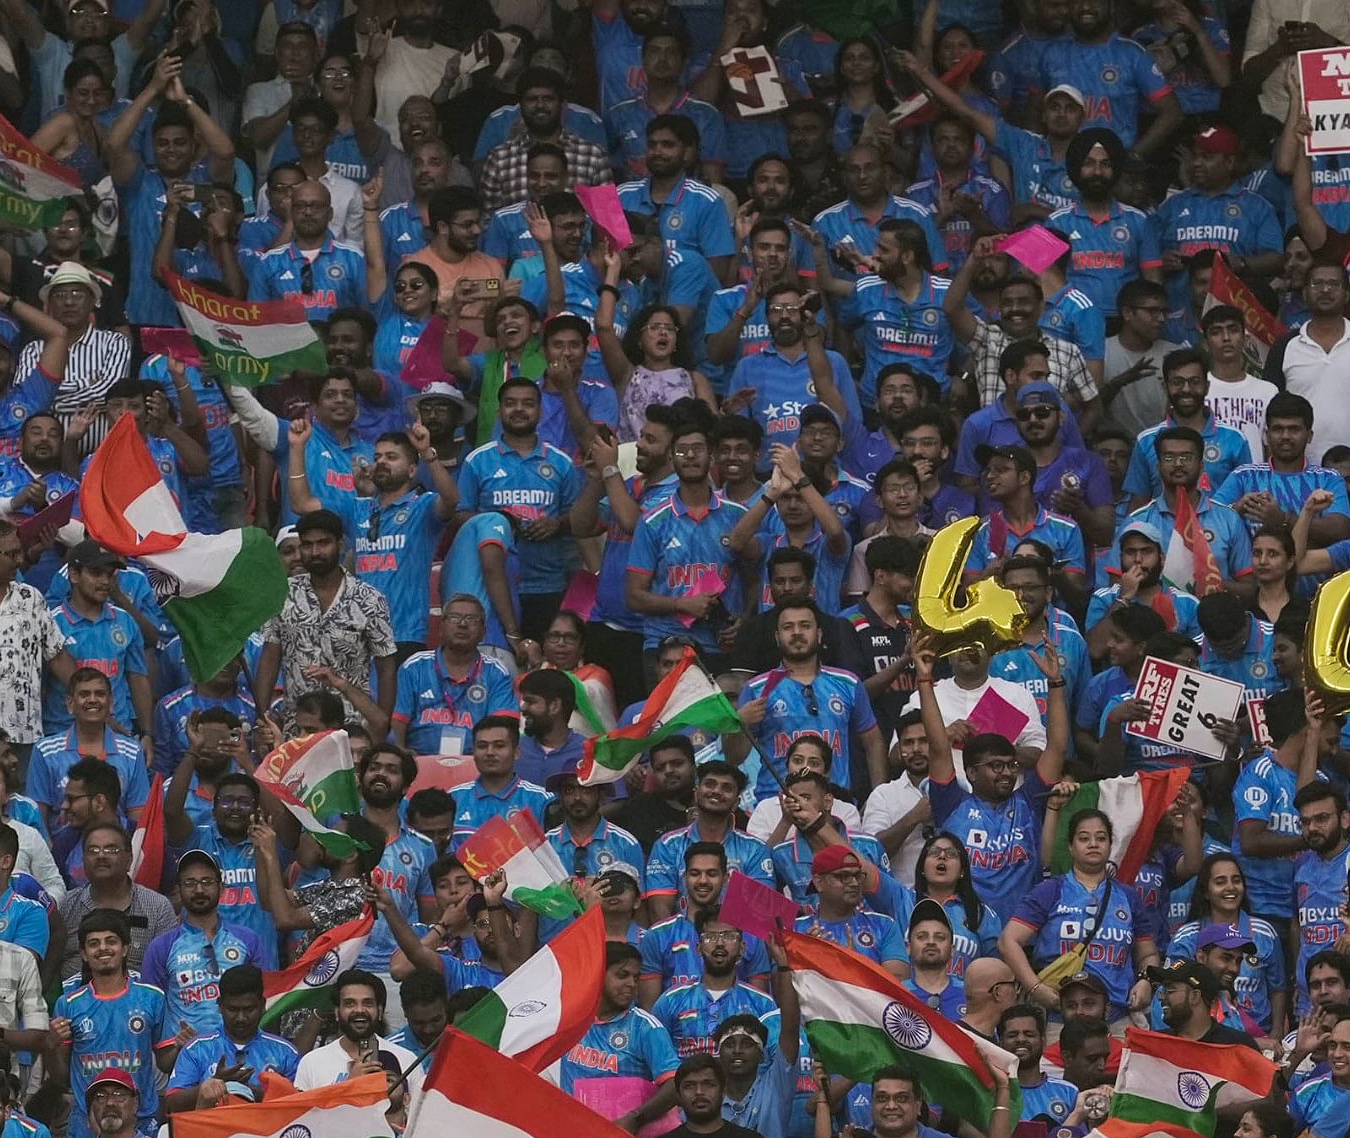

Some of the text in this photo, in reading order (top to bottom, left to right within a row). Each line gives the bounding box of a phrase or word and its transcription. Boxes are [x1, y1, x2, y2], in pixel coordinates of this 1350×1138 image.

[1315, 109, 1350, 131] KYA
[1177, 226, 1239, 242] DREAM11
[1071, 250, 1125, 268] INDIA
[177, 278, 261, 323] bharat
[214, 349, 270, 383] army
[493, 491, 553, 505] DREAM11
[356, 555, 397, 571] INDIA
[1149, 676, 1176, 726] TYRES
[1169, 675, 1202, 745] GREAT
[421, 708, 472, 727] INDIA
[1195, 710, 1218, 731] 6
[80, 1052, 141, 1073] INDIA
[569, 1046, 618, 1072] INDIA
